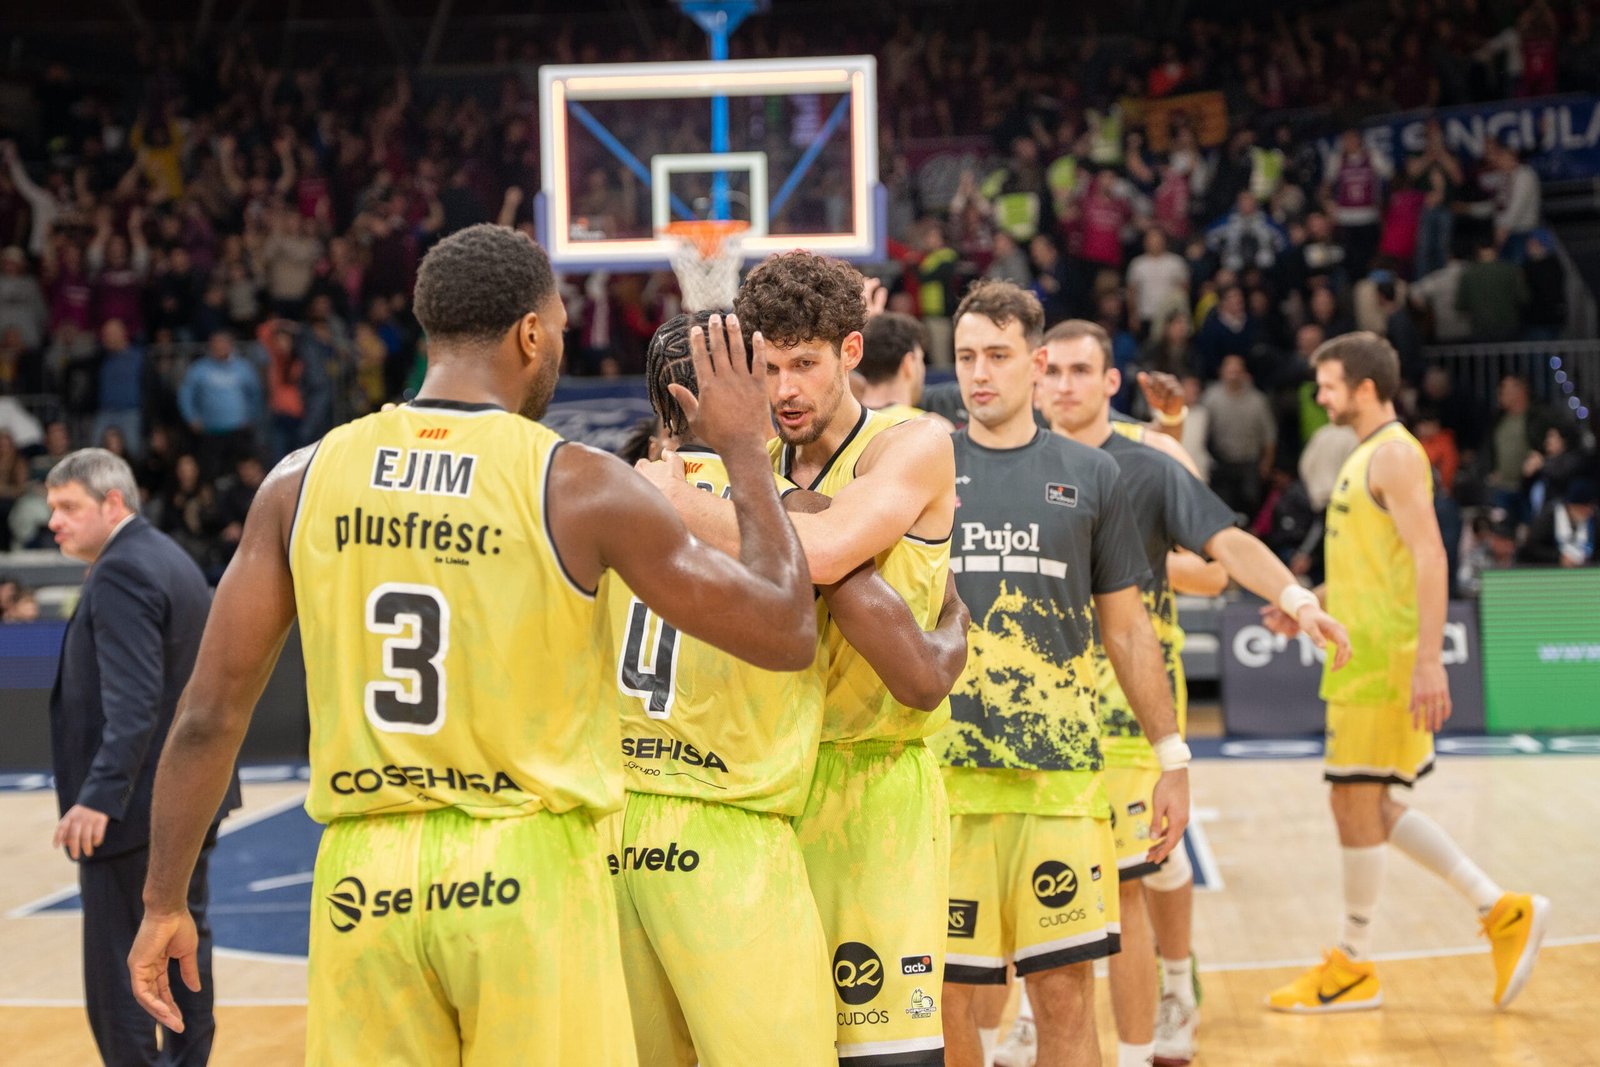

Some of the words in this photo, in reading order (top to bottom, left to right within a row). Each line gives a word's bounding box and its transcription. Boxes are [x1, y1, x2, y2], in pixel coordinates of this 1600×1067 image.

[371, 446, 477, 498] EJIM
[961, 522, 1039, 556] Pujol
[366, 582, 450, 735] 3
[617, 595, 681, 719] 4
[330, 764, 524, 795] COSEHISA
[627, 761, 661, 777] Grupo
[1033, 868, 1077, 898] Q2
[1038, 908, 1087, 928] CUDÓS
[834, 958, 881, 988] Q2
[904, 963, 926, 973] acb
[836, 1009, 889, 1026] CUDÓS
